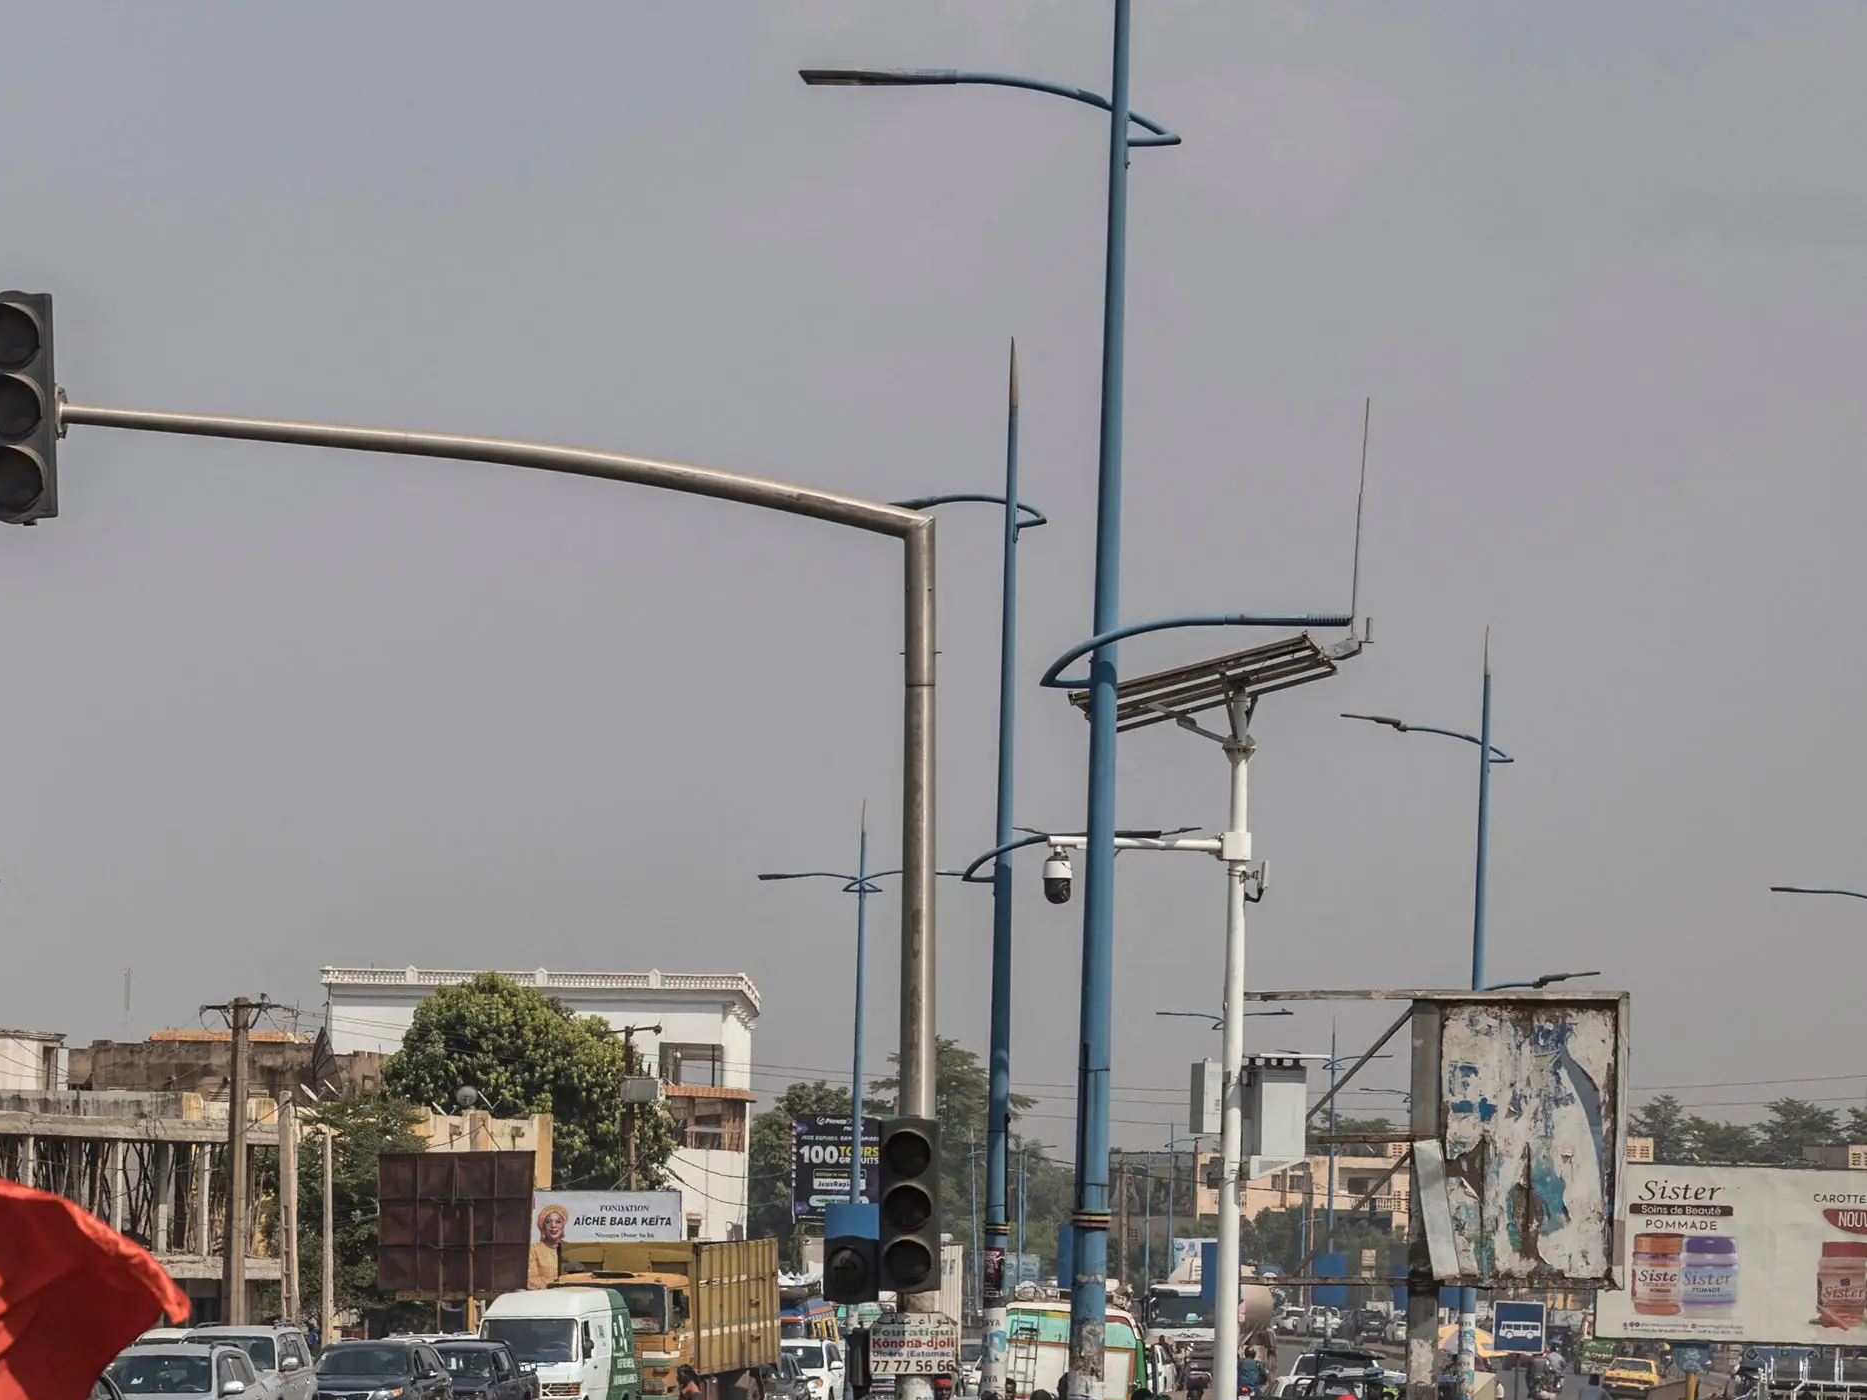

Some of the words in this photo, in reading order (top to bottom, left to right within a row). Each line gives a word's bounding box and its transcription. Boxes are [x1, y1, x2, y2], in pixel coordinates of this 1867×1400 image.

[799, 1145, 838, 1164] 100
[1638, 1180, 1722, 1201] Sister
[1813, 1194, 1866, 1204] CAROTTE
[599, 1204, 650, 1212] FONDATION
[1641, 1204, 1668, 1214] Soins
[1671, 1206, 1683, 1215] de
[1685, 1205, 1722, 1216] Beauté
[609, 1216, 638, 1226] BABA
[640, 1214, 672, 1226] KEÏTA
[1645, 1219, 1718, 1231] POMMADE
[1638, 1269, 1678, 1283] Siste
[1685, 1272, 1733, 1286] Sister
[1823, 1286, 1864, 1299] Sister
[872, 1360, 889, 1372] 77
[894, 1360, 911, 1372] 77
[915, 1360, 933, 1372] 56
[937, 1360, 955, 1372] 66
